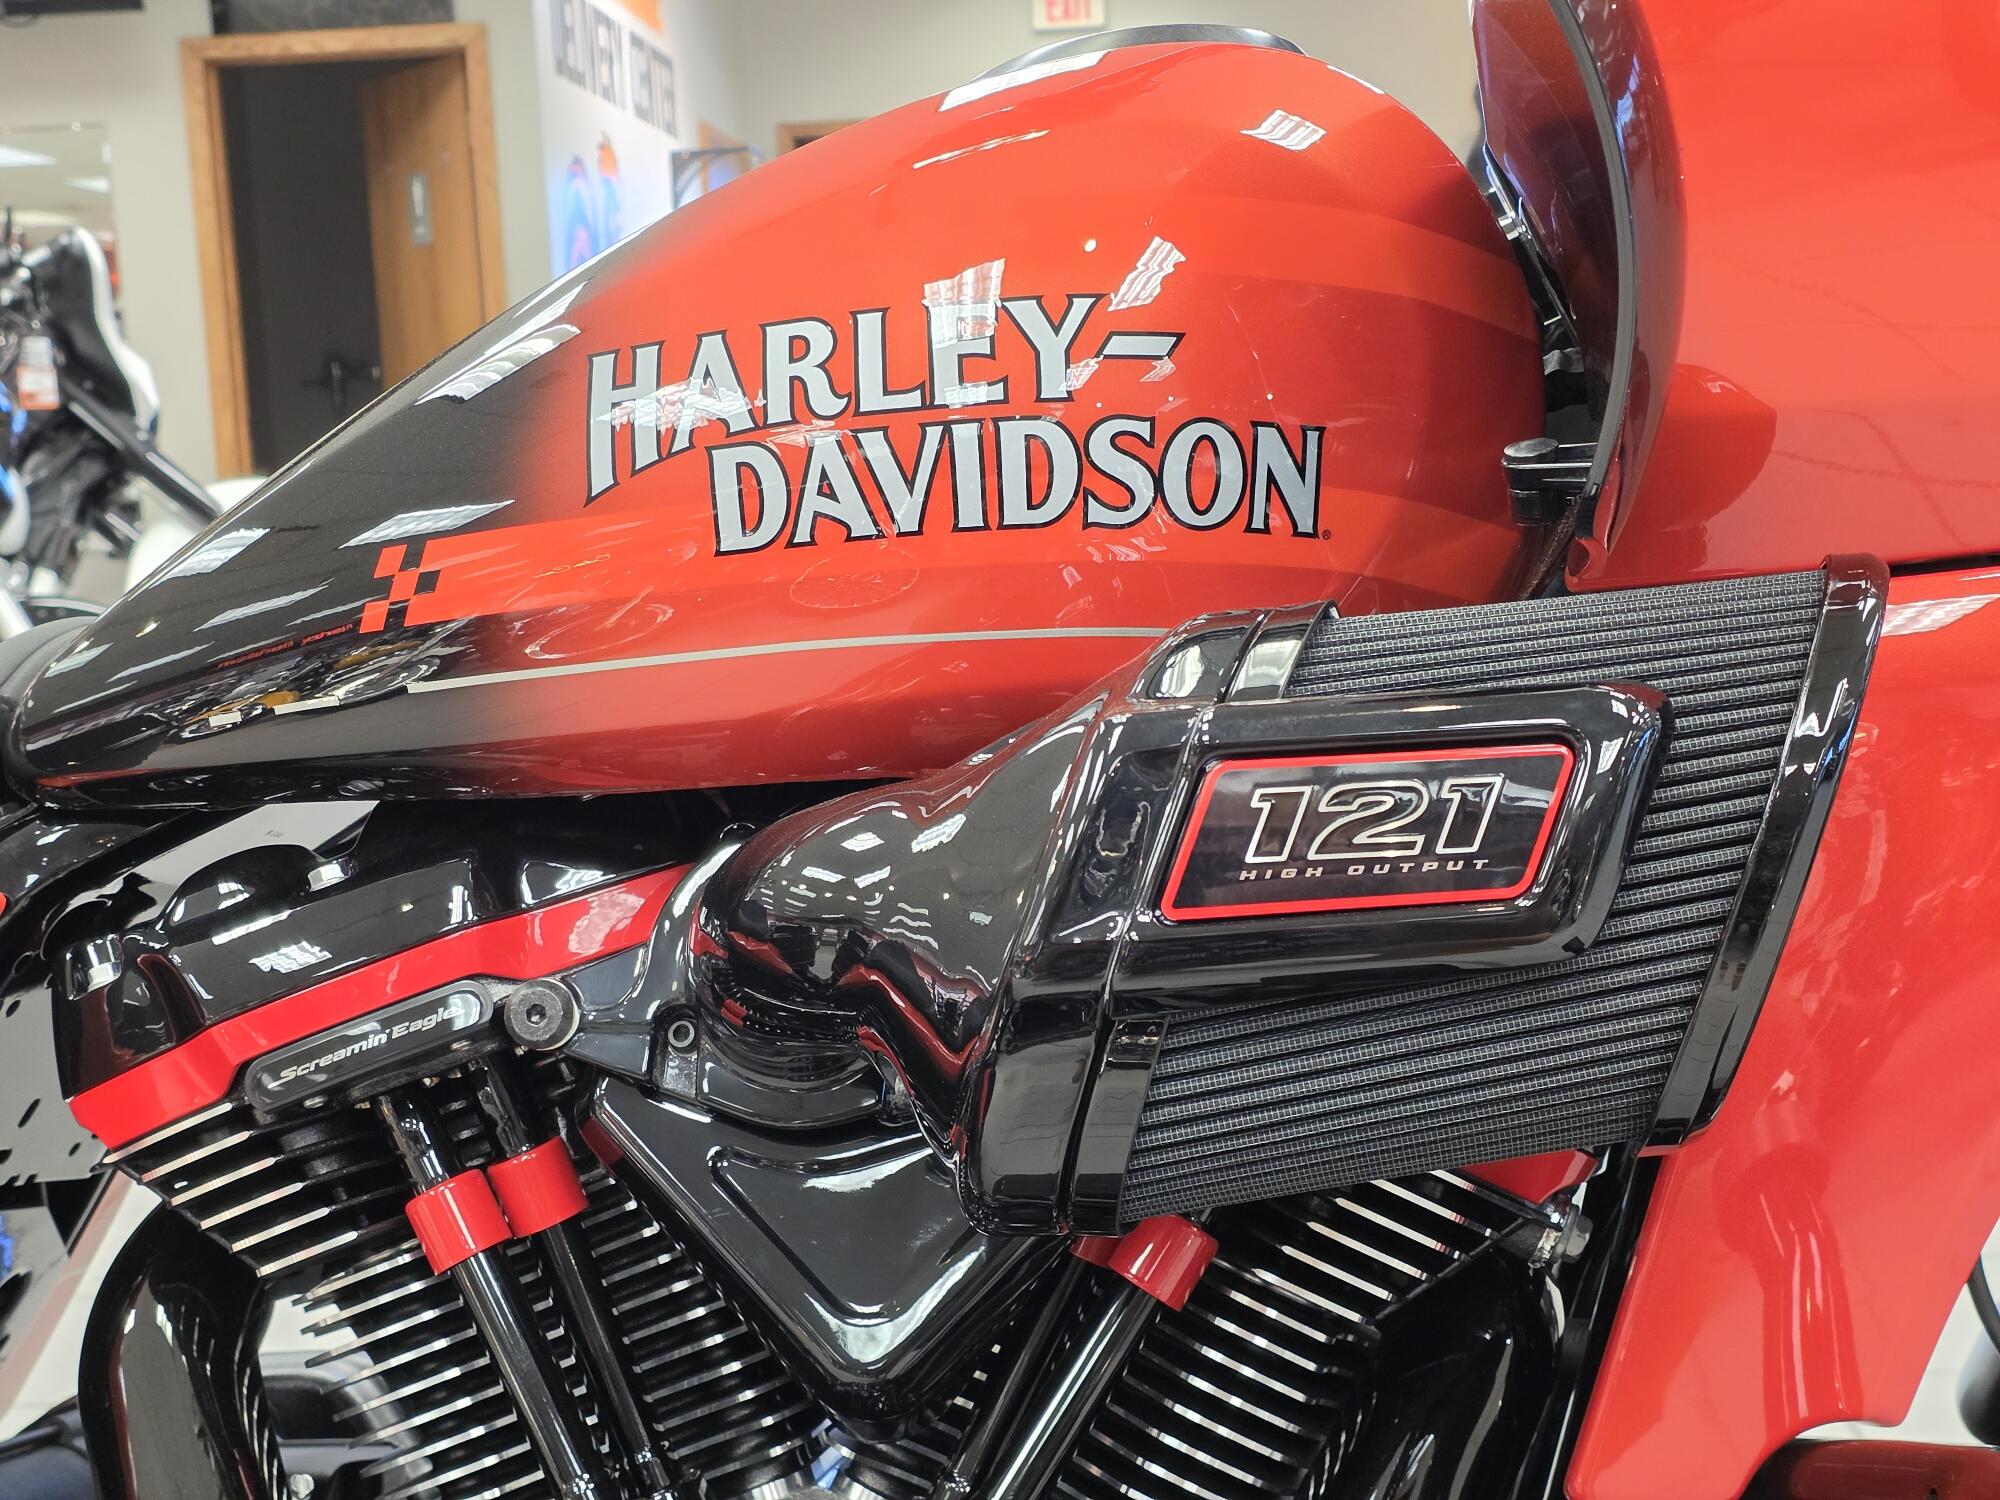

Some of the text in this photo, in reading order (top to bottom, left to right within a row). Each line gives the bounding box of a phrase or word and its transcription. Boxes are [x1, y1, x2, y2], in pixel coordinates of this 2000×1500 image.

[584, 293, 1187, 508] HARLEY-
[704, 416, 1327, 558] DAVIDSON
[1245, 774, 1505, 864] 121
[1239, 859, 1490, 881] HIGH OUTPUT
[391, 1006, 465, 1039] Eagle
